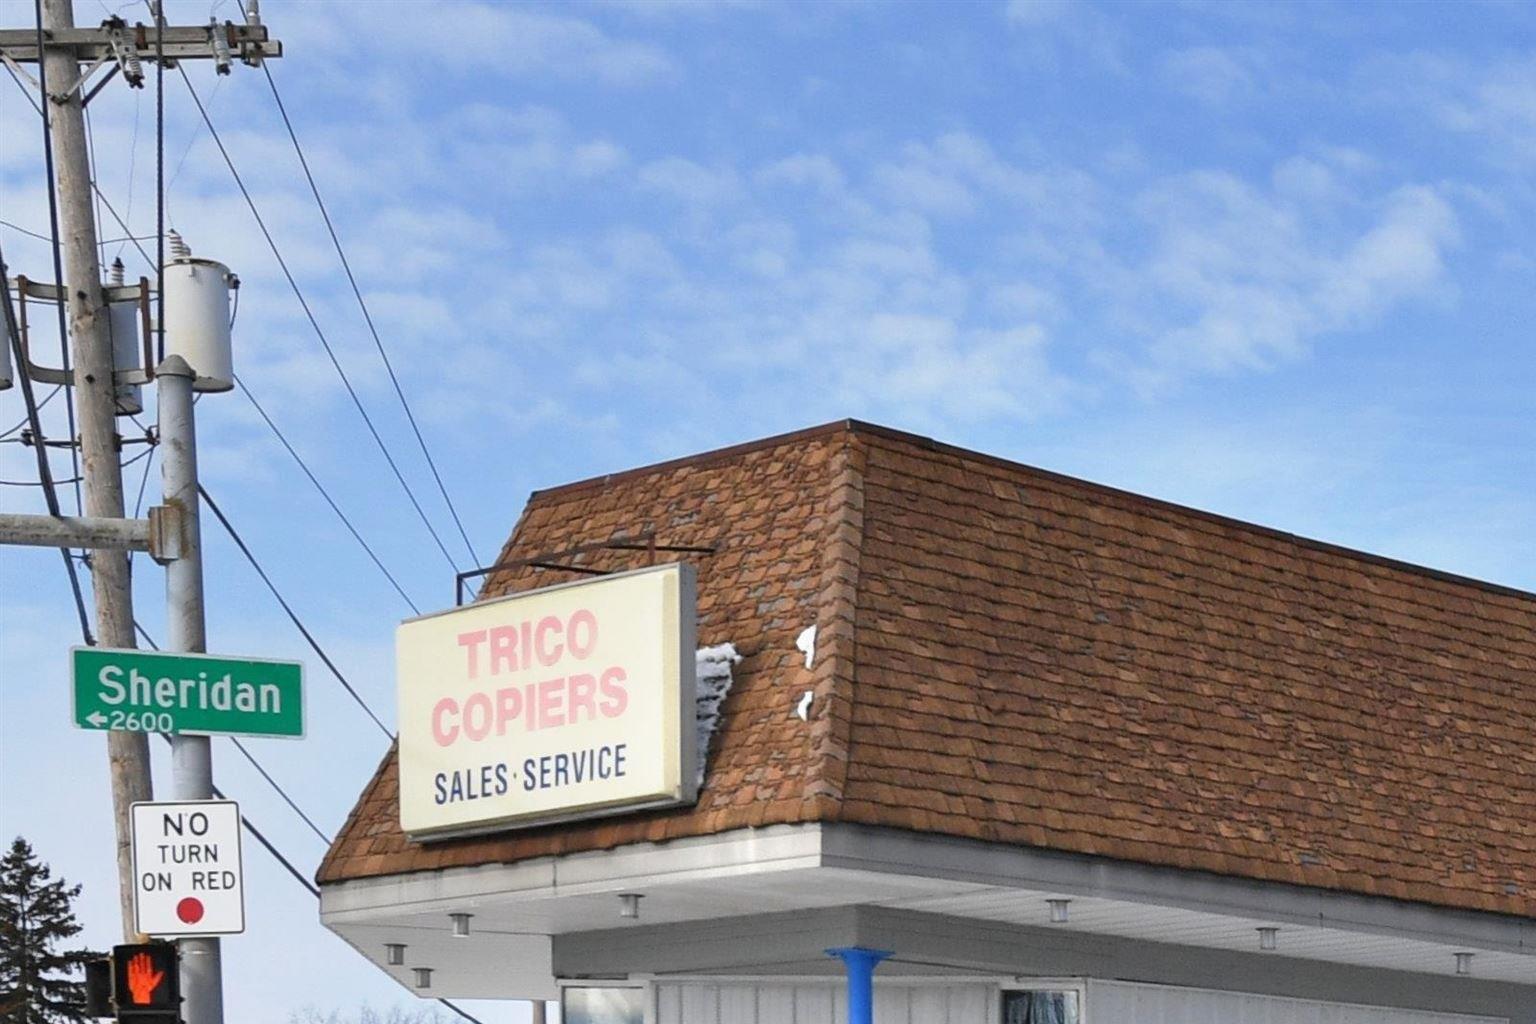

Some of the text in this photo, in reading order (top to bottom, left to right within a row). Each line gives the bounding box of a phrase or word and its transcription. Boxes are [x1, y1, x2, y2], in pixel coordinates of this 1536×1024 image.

[458, 609, 598, 679] TRICO
[98, 665, 281, 714] Sheridan
[431, 666, 629, 747] COPIERS
[111, 710, 173, 733] 2600
[435, 744, 627, 806] SALES SERVICE
[163, 812, 209, 837] NO
[158, 844, 218, 864] TURN
[142, 870, 236, 892] ON RED
